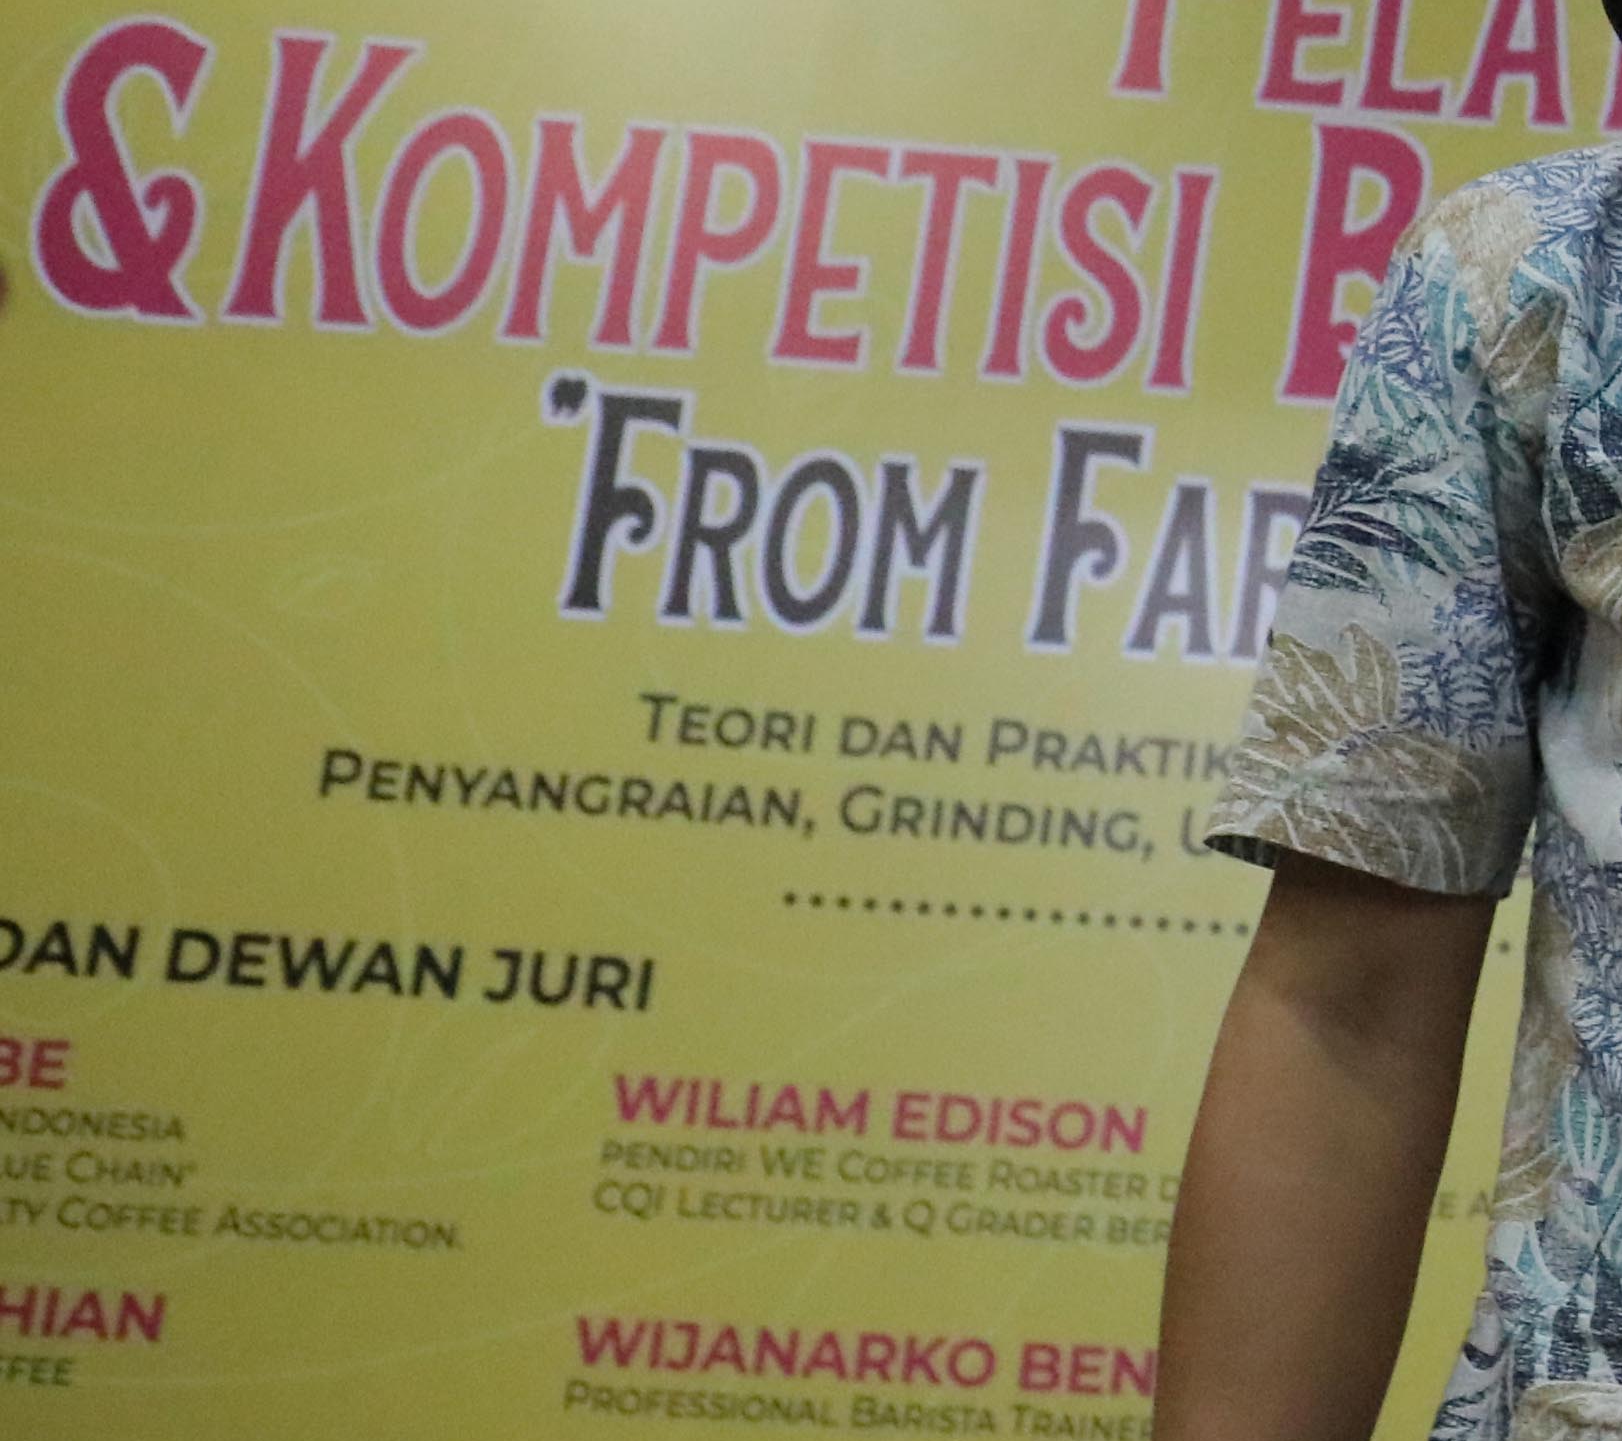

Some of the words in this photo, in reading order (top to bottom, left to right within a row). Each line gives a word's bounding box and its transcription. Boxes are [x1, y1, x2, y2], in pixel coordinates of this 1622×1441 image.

[33, 13, 212, 326] &
[220, 28, 1217, 394] KOMPETISI
[640, 693, 816, 754] TEORI
[838, 720, 963, 766] DAN
[986, 719, 1233, 783] PRAKTIK
[318, 747, 817, 840] PENYANGRAIAN,
[840, 786, 1156, 864] GRINDING,
[163, 928, 464, 1002] DEWAN
[483, 949, 656, 1011] JURI
[612, 1072, 871, 1140] WILIAM
[890, 1090, 1149, 1155] EDISON
[600, 1140, 747, 1174] PENDIRI
[758, 1146, 829, 1181] WE
[836, 1149, 977, 1192] COFFEE
[986, 1159, 1151, 1200] ROASTER
[57, 1196, 205, 1238] COFFEE
[592, 1178, 666, 1219] CQI
[675, 1185, 862, 1230] LECTURER
[868, 1203, 894, 1231] &
[901, 1198, 938, 1238] Q
[944, 1201, 1097, 1242] GRADER
[575, 1315, 998, 1390] WIJANARKO
[562, 1379, 838, 1429] PROFESSIONAL
[850, 1394, 998, 1435] BARISTA
